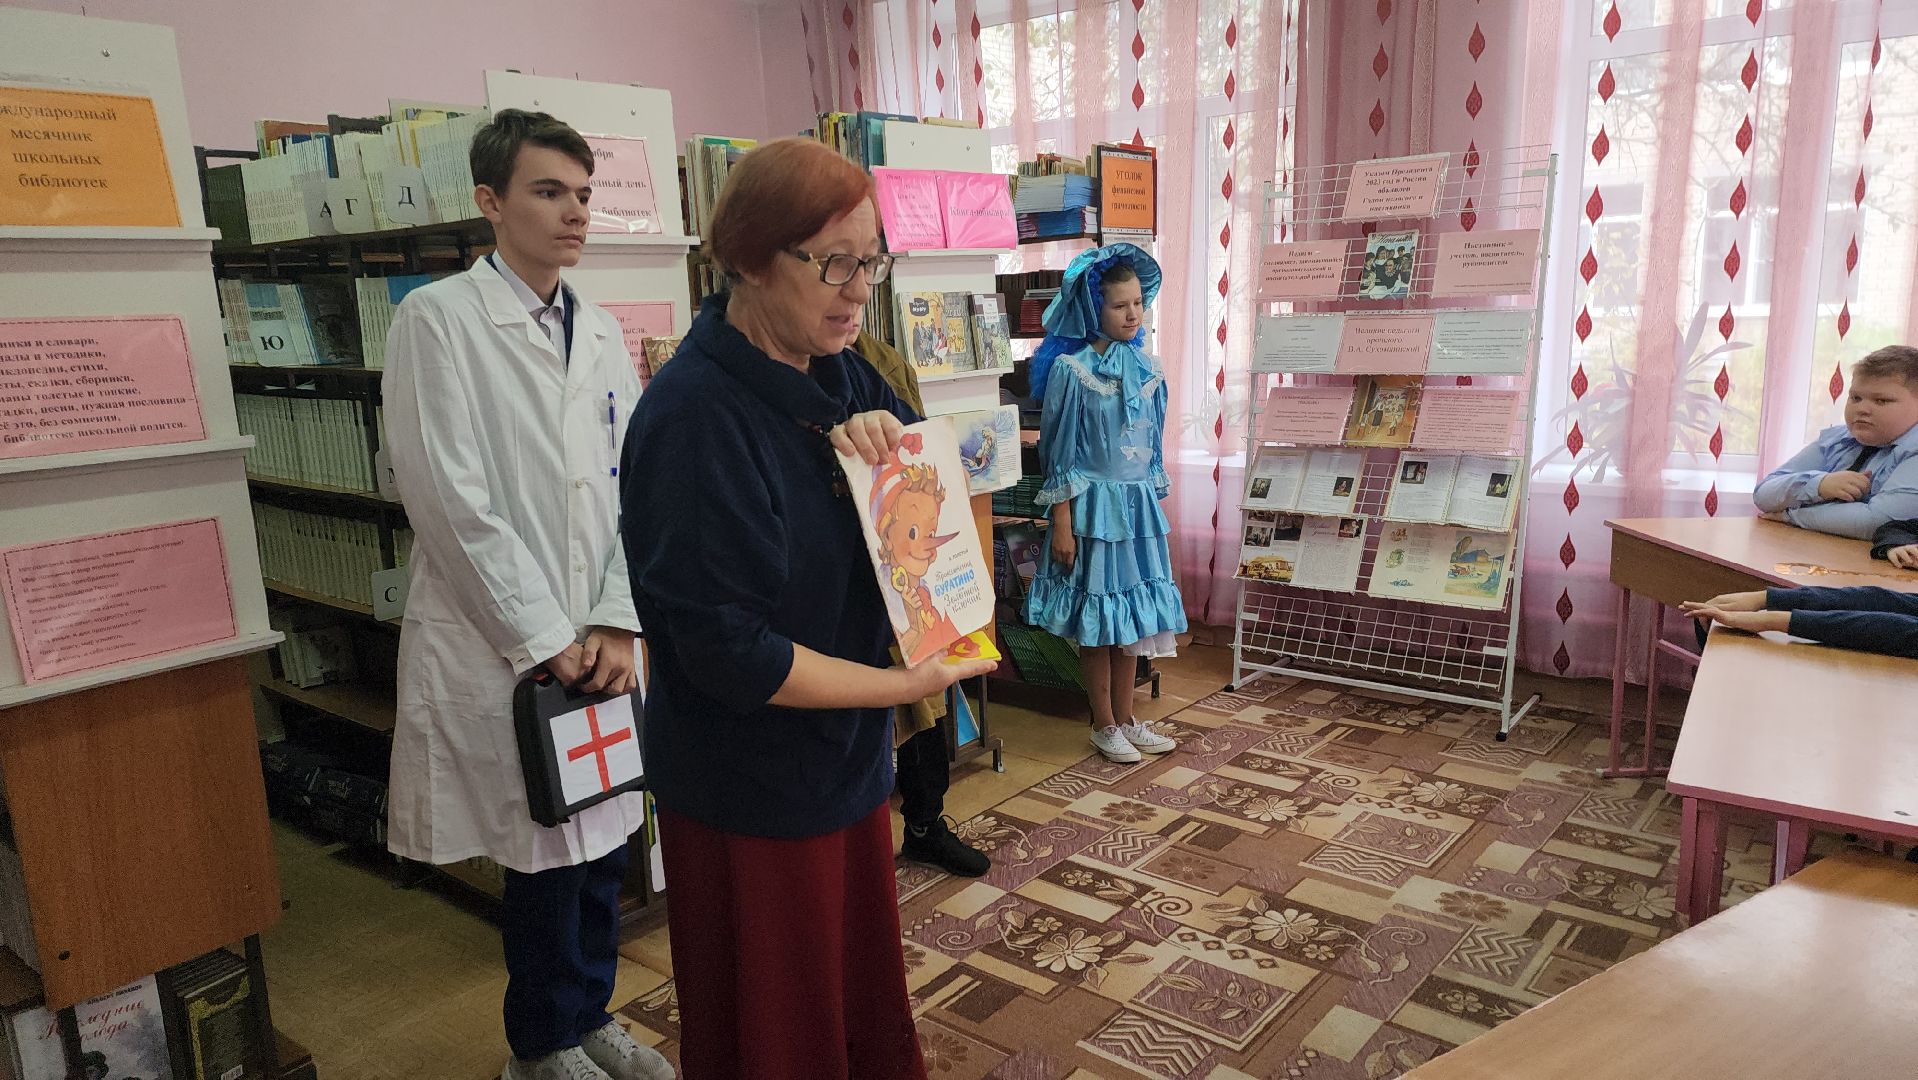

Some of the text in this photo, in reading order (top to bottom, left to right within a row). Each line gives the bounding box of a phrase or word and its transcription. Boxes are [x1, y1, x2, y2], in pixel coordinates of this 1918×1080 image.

[0, 103, 117, 121] ждународный
[10, 129, 93, 142] месячник
[13, 152, 103, 166] школьных
[18, 173, 109, 189] библиотек
[1115, 170, 1143, 181] УГОЛОК
[625, 180, 647, 189] день
[398, 185, 416, 210] Д
[319, 201, 332, 218] А
[345, 198, 358, 216] Г
[601, 206, 652, 218] библиотек
[35, 340, 43, 348] и
[260, 335, 284, 351] Ю
[34, 352, 42, 360] и
[34, 390, 84, 401] толстые
[87, 389, 95, 397] и
[81, 401, 125, 412] нужная
[128, 397, 186, 408] пословица
[39, 416, 58, 426] без
[4, 430, 74, 444] библиотеке
[78, 424, 138, 437] школьной
[934, 568, 975, 598] БУРАТИНО
[384, 586, 398, 603] С
